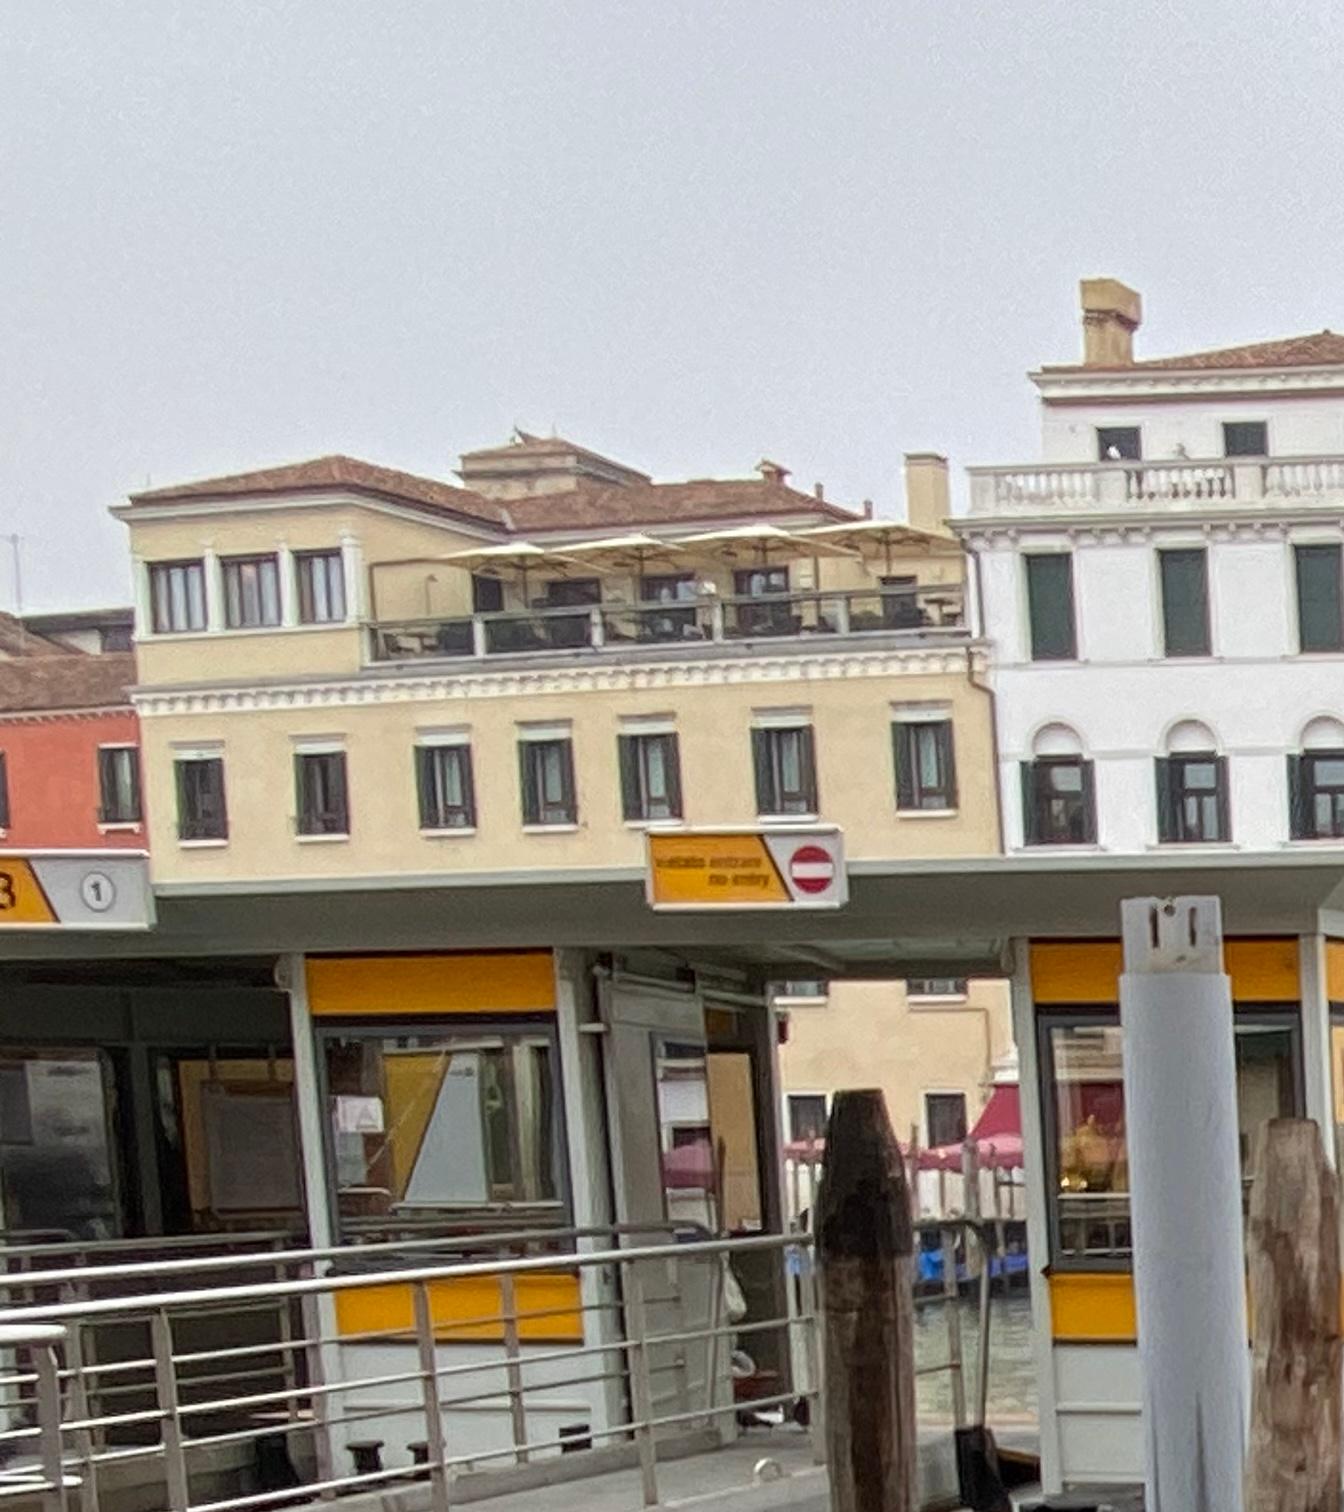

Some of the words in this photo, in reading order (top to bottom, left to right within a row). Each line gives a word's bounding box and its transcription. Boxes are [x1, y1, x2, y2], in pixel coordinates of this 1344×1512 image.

[708, 874, 728, 886] no
[732, 874, 770, 889] entry
[91, 881, 102, 901] 1
